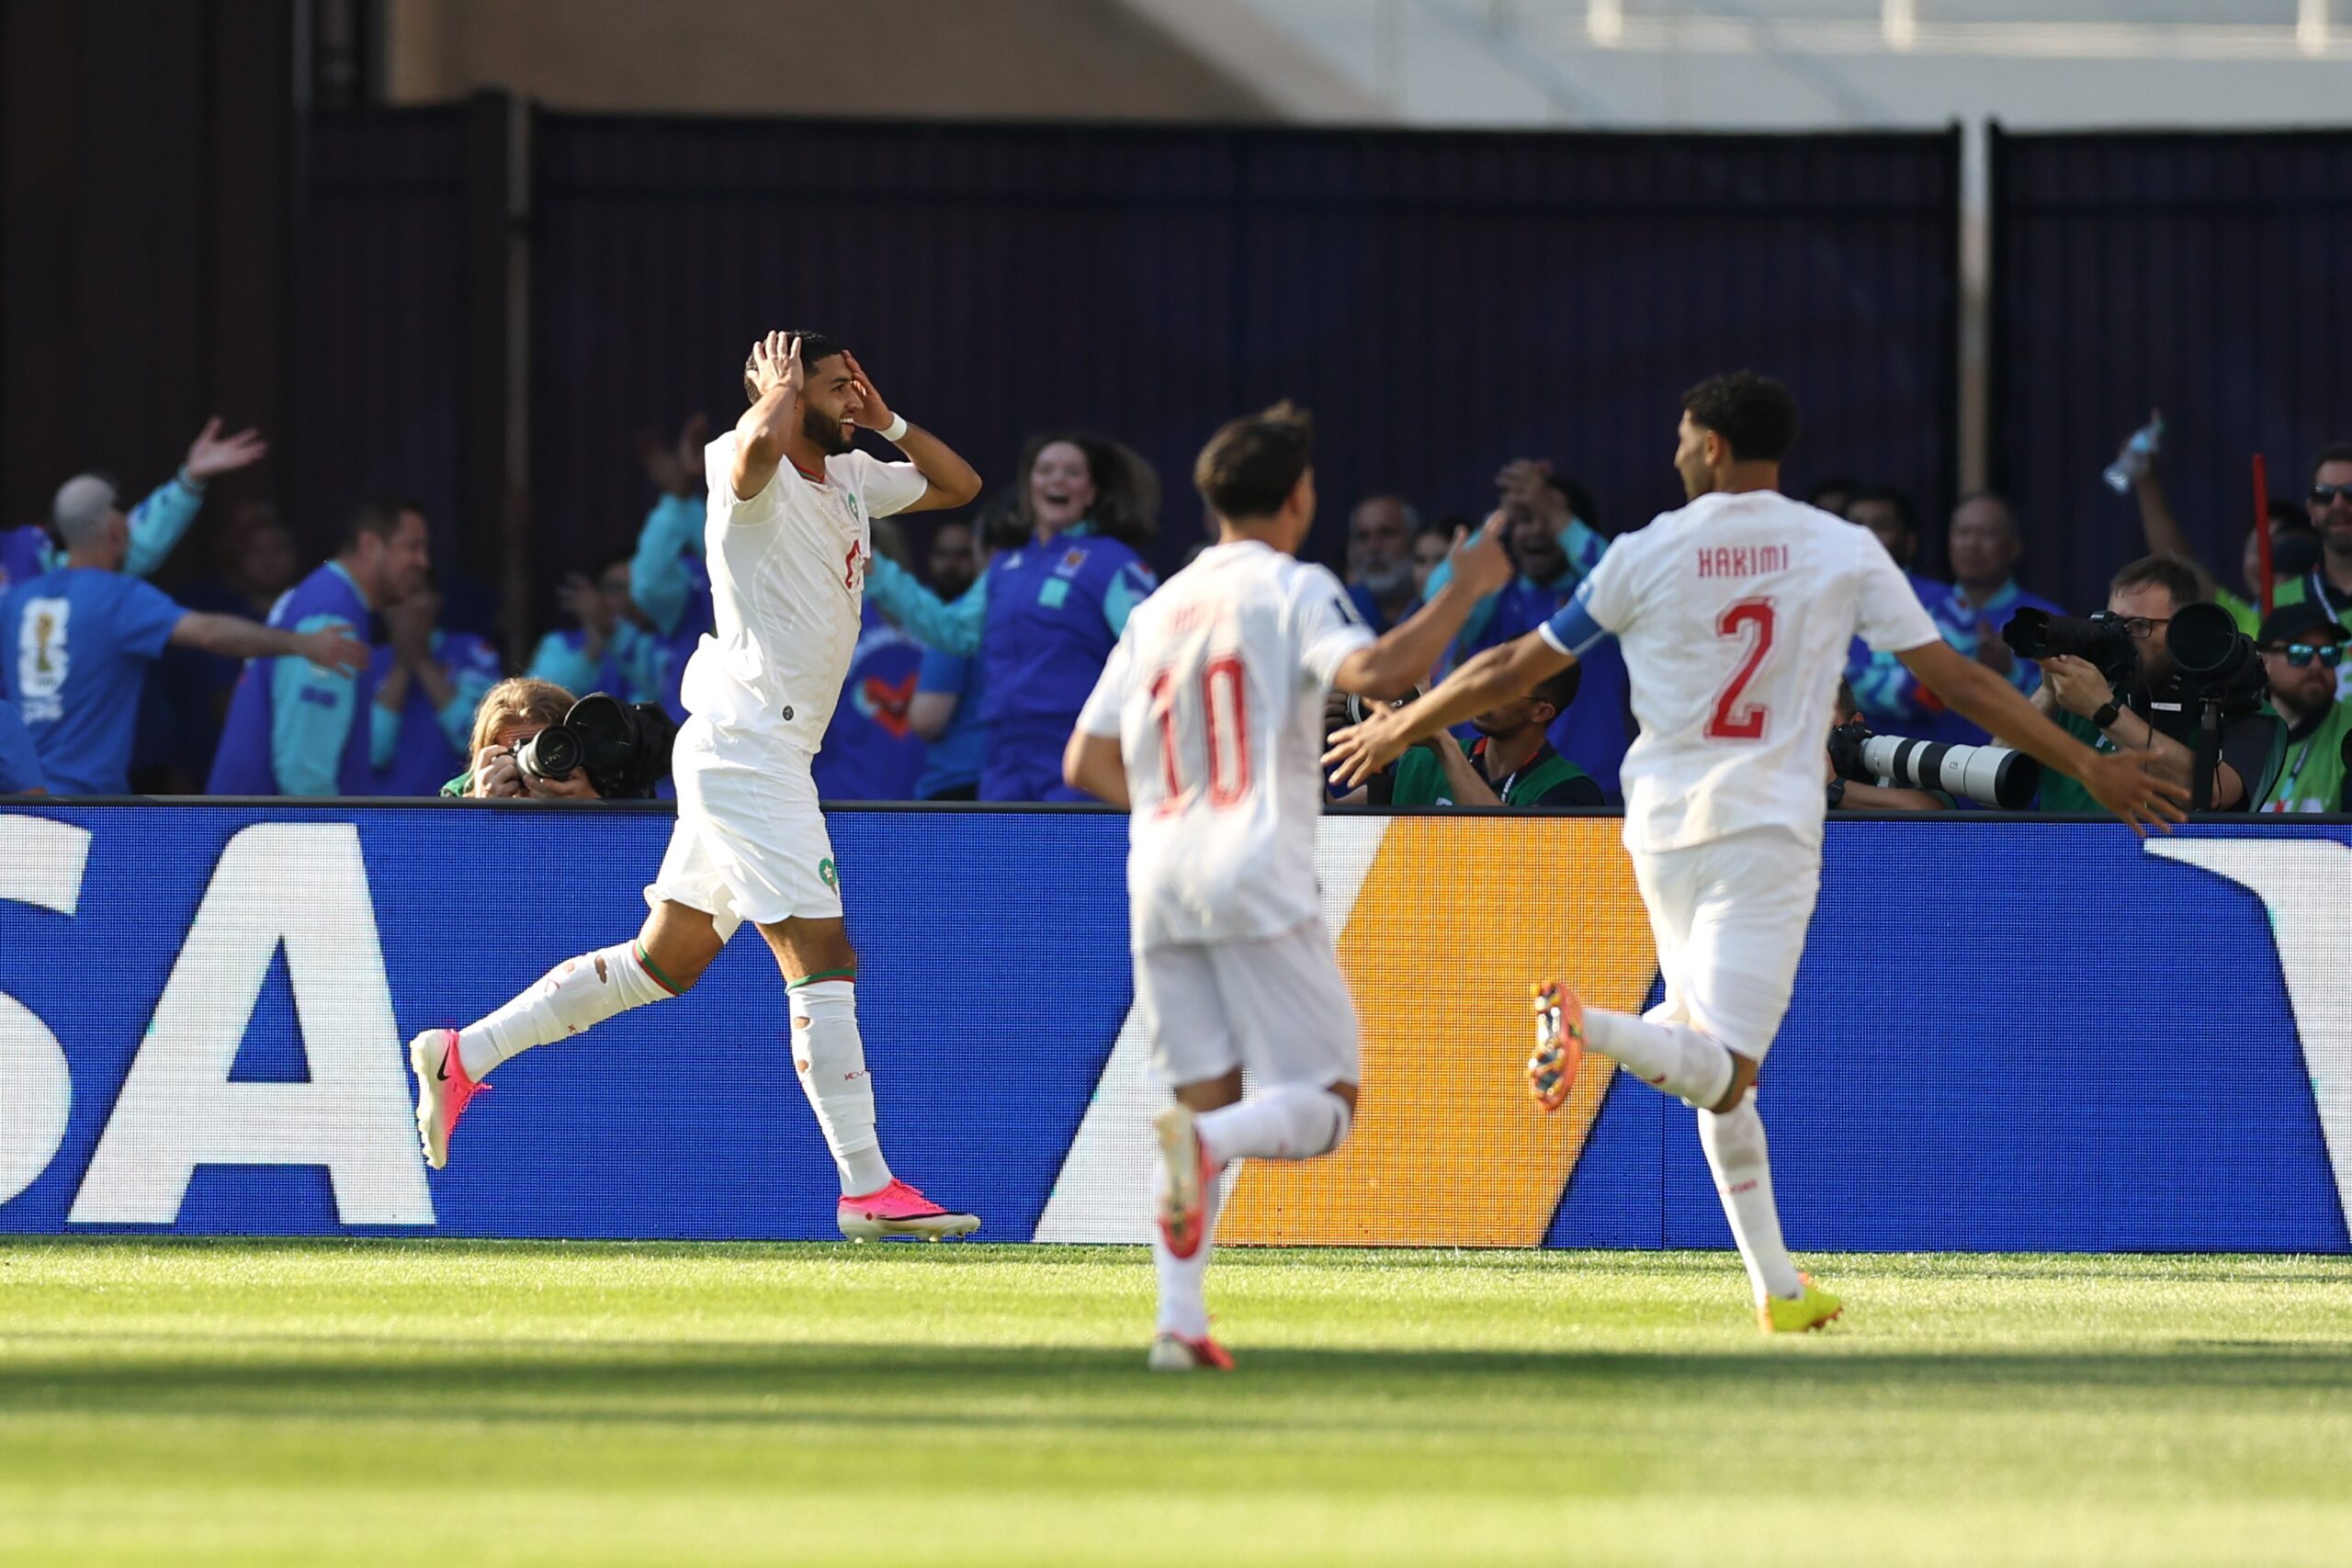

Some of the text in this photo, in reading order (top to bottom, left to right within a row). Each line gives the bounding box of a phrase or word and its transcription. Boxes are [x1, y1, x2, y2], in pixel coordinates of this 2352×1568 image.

[1698, 545, 1788, 578] HAKIMI
[1148, 655, 1251, 818] 10
[1703, 596, 1775, 739] 2
